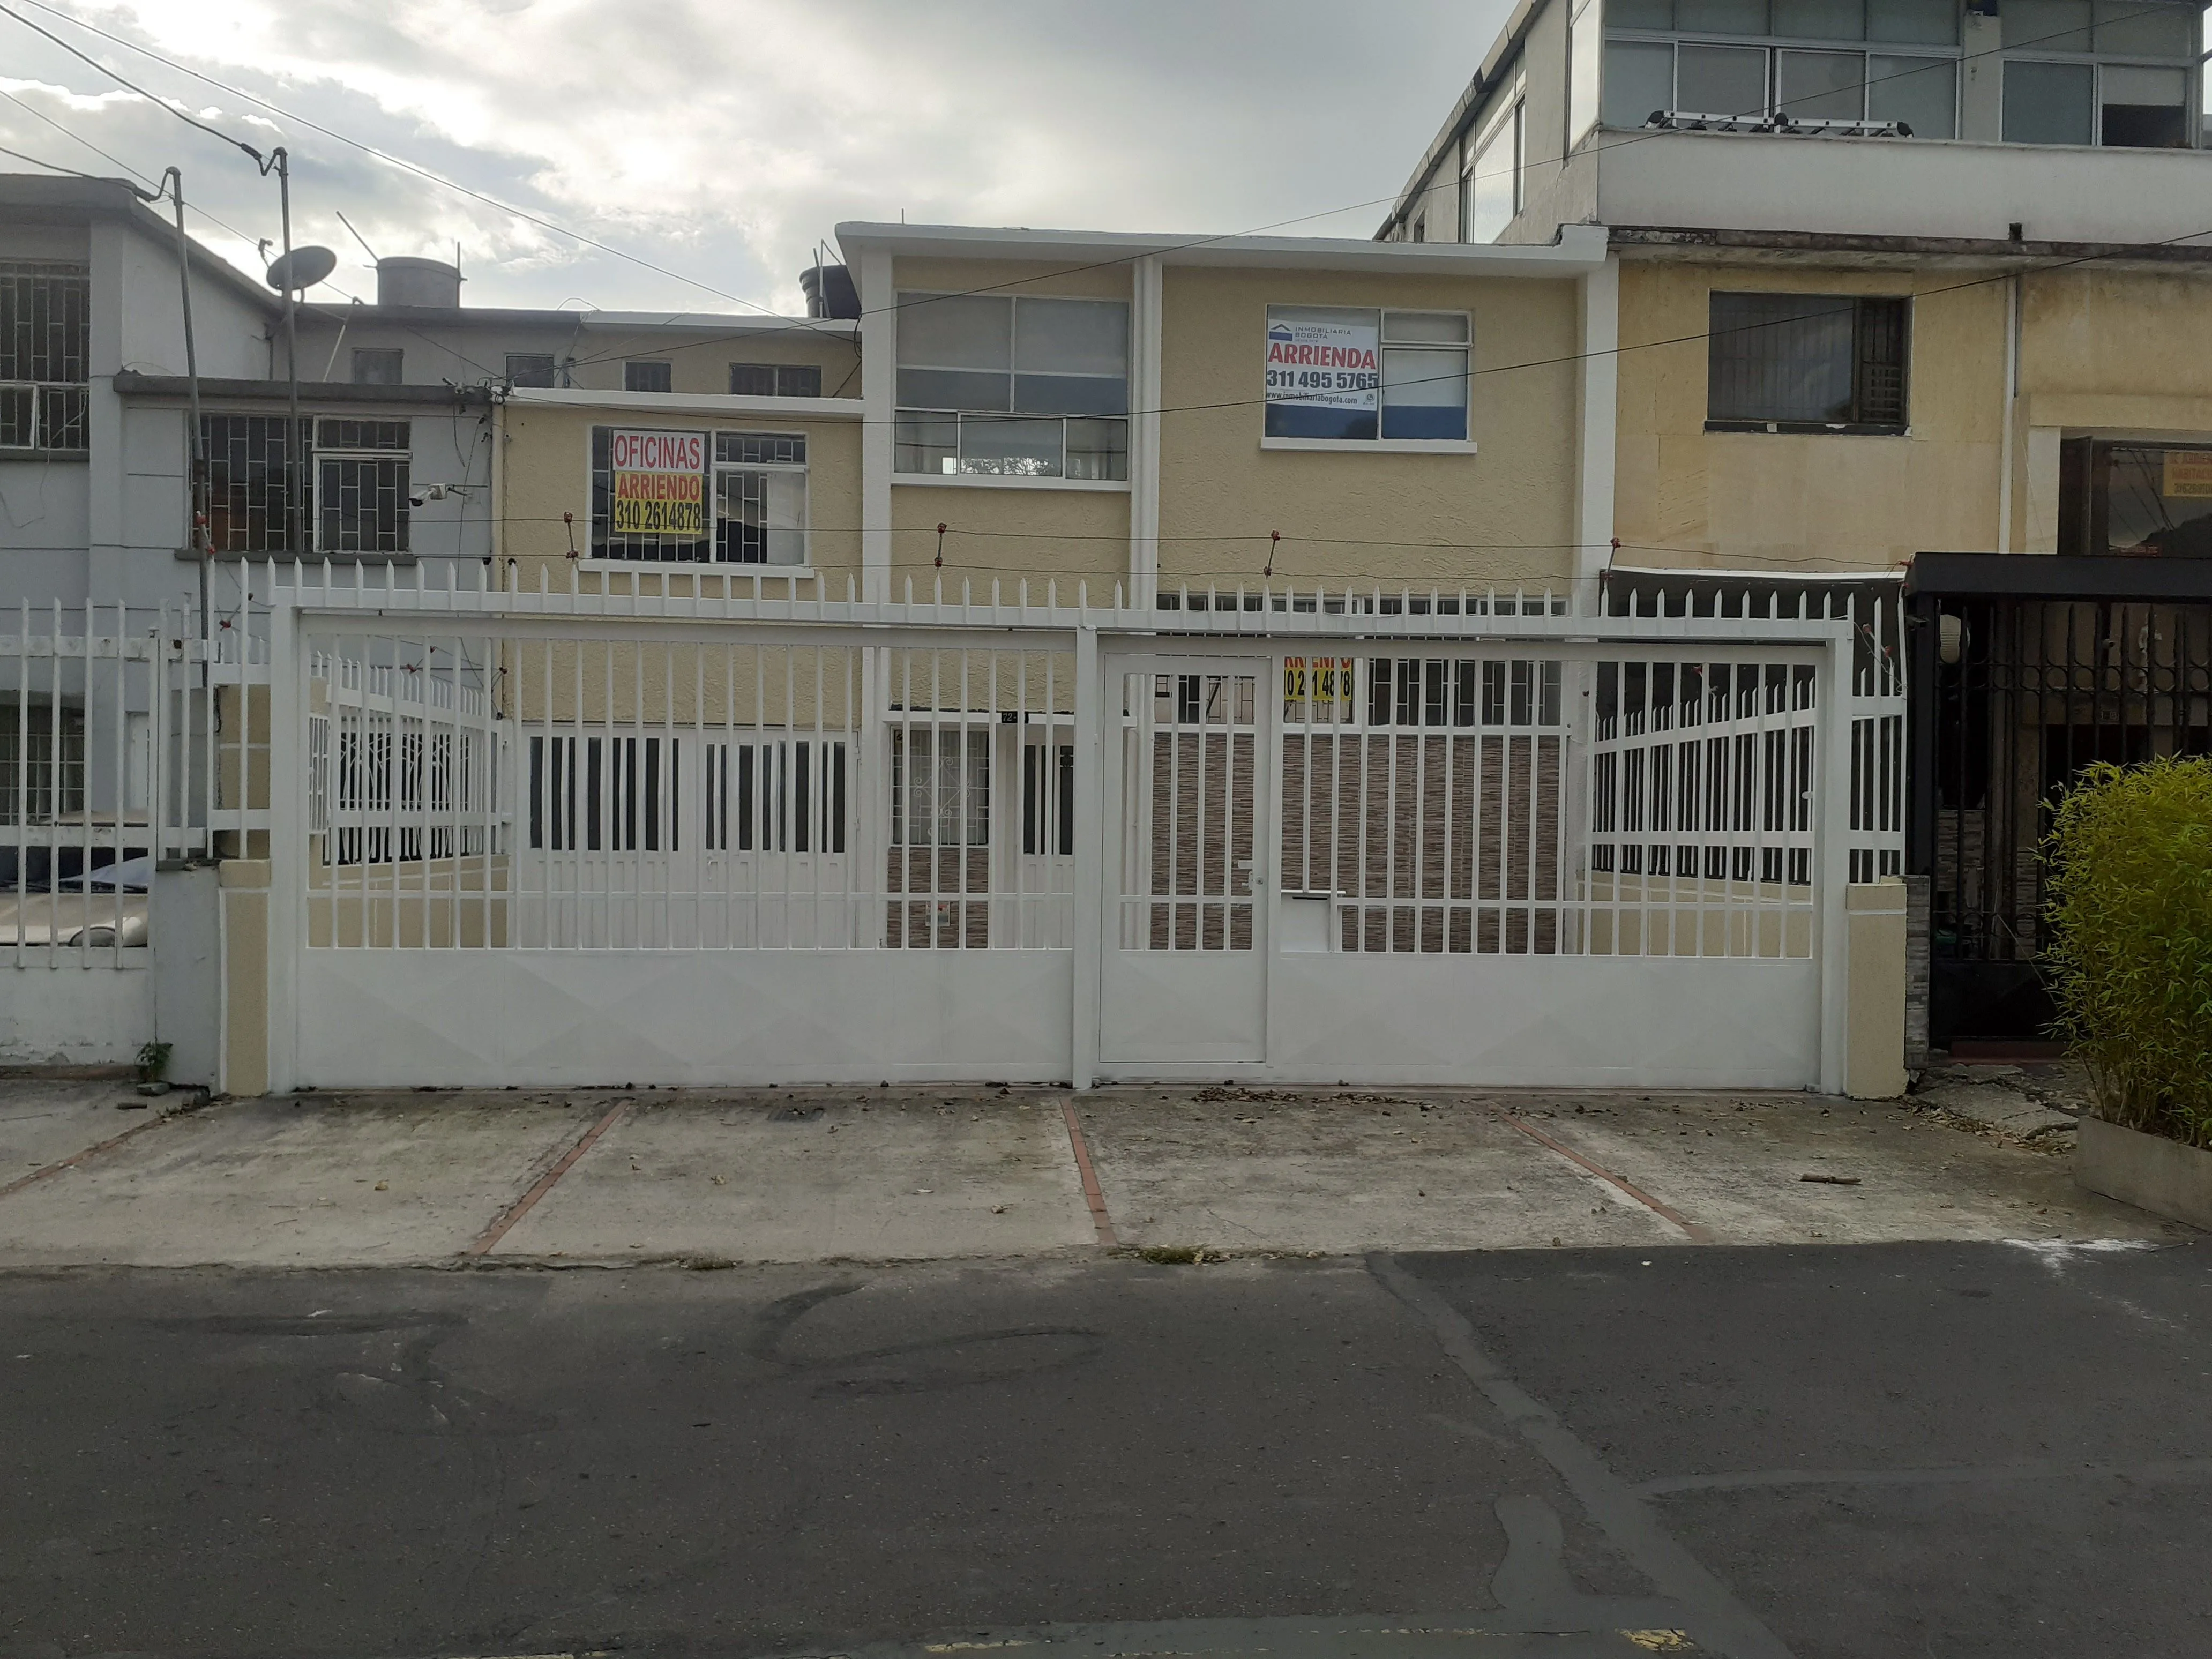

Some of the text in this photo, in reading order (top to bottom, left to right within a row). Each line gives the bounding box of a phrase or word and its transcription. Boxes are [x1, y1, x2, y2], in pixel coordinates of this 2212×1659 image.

[1295, 326, 1351, 335] INMOBILIARIA
[1268, 342, 1376, 370] ARRIENDA
[1267, 370, 1378, 390] 311 495 5765
[1266, 391, 1357, 405] www.inmobiliariabogota.com
[615, 435, 700, 469] OFICINAS
[617, 473, 700, 502] ARRIENDO
[617, 500, 701, 531] 310 2614878
